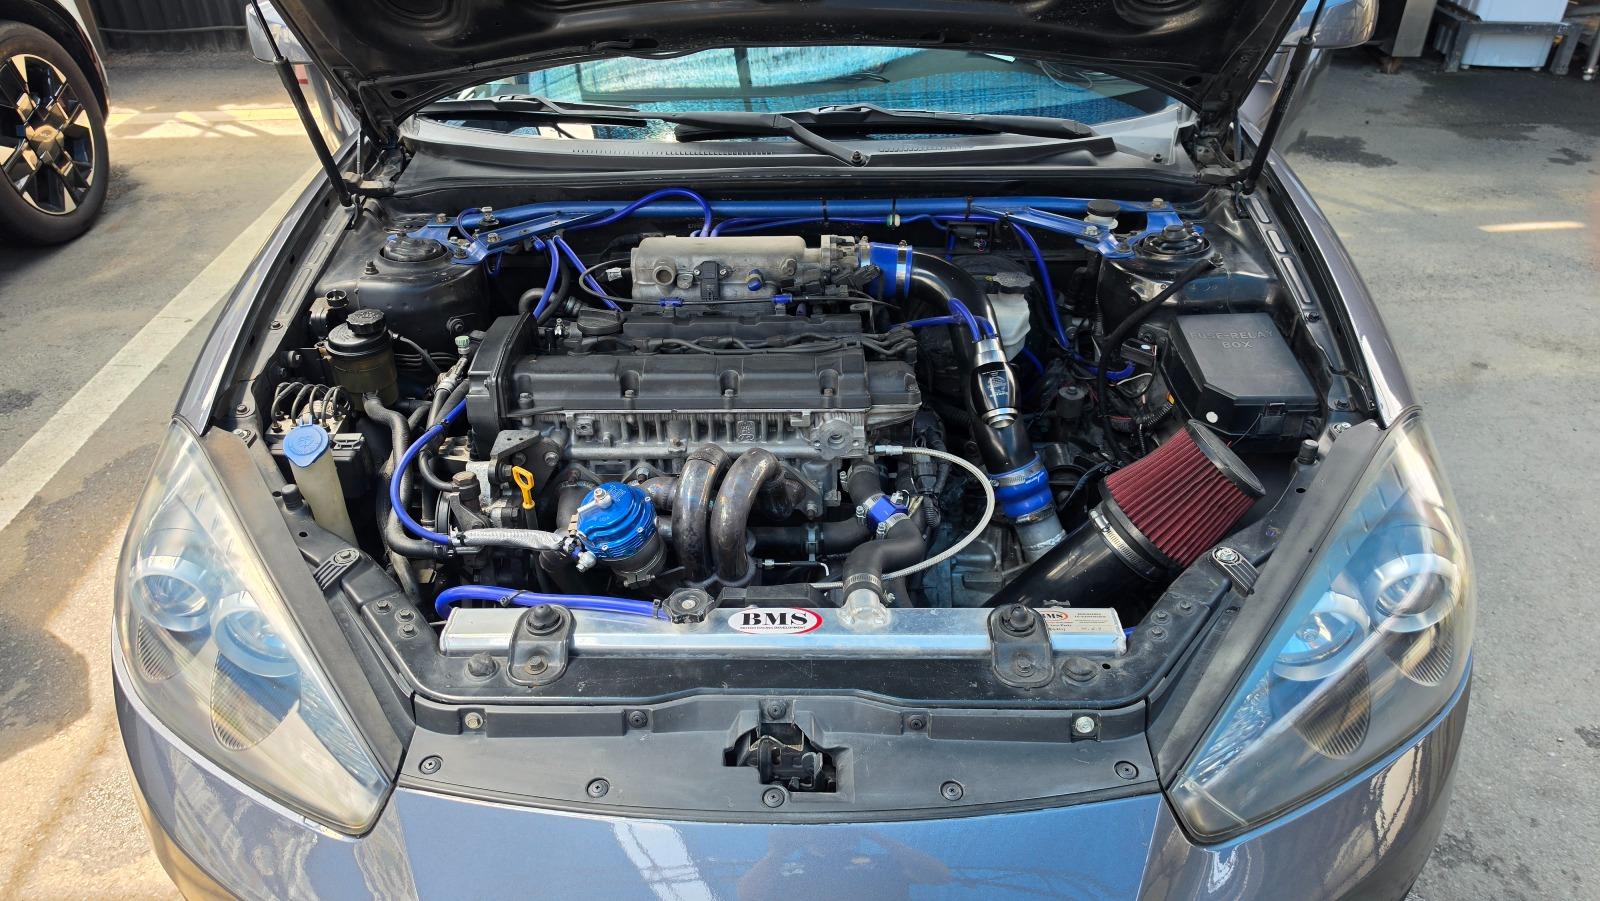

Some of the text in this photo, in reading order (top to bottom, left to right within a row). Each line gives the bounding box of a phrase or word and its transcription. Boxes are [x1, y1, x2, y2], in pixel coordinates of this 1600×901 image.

[1190, 330, 1273, 339] FUSE-RELAY
[1222, 341, 1253, 349] BOX
[741, 612, 808, 626] BMS
